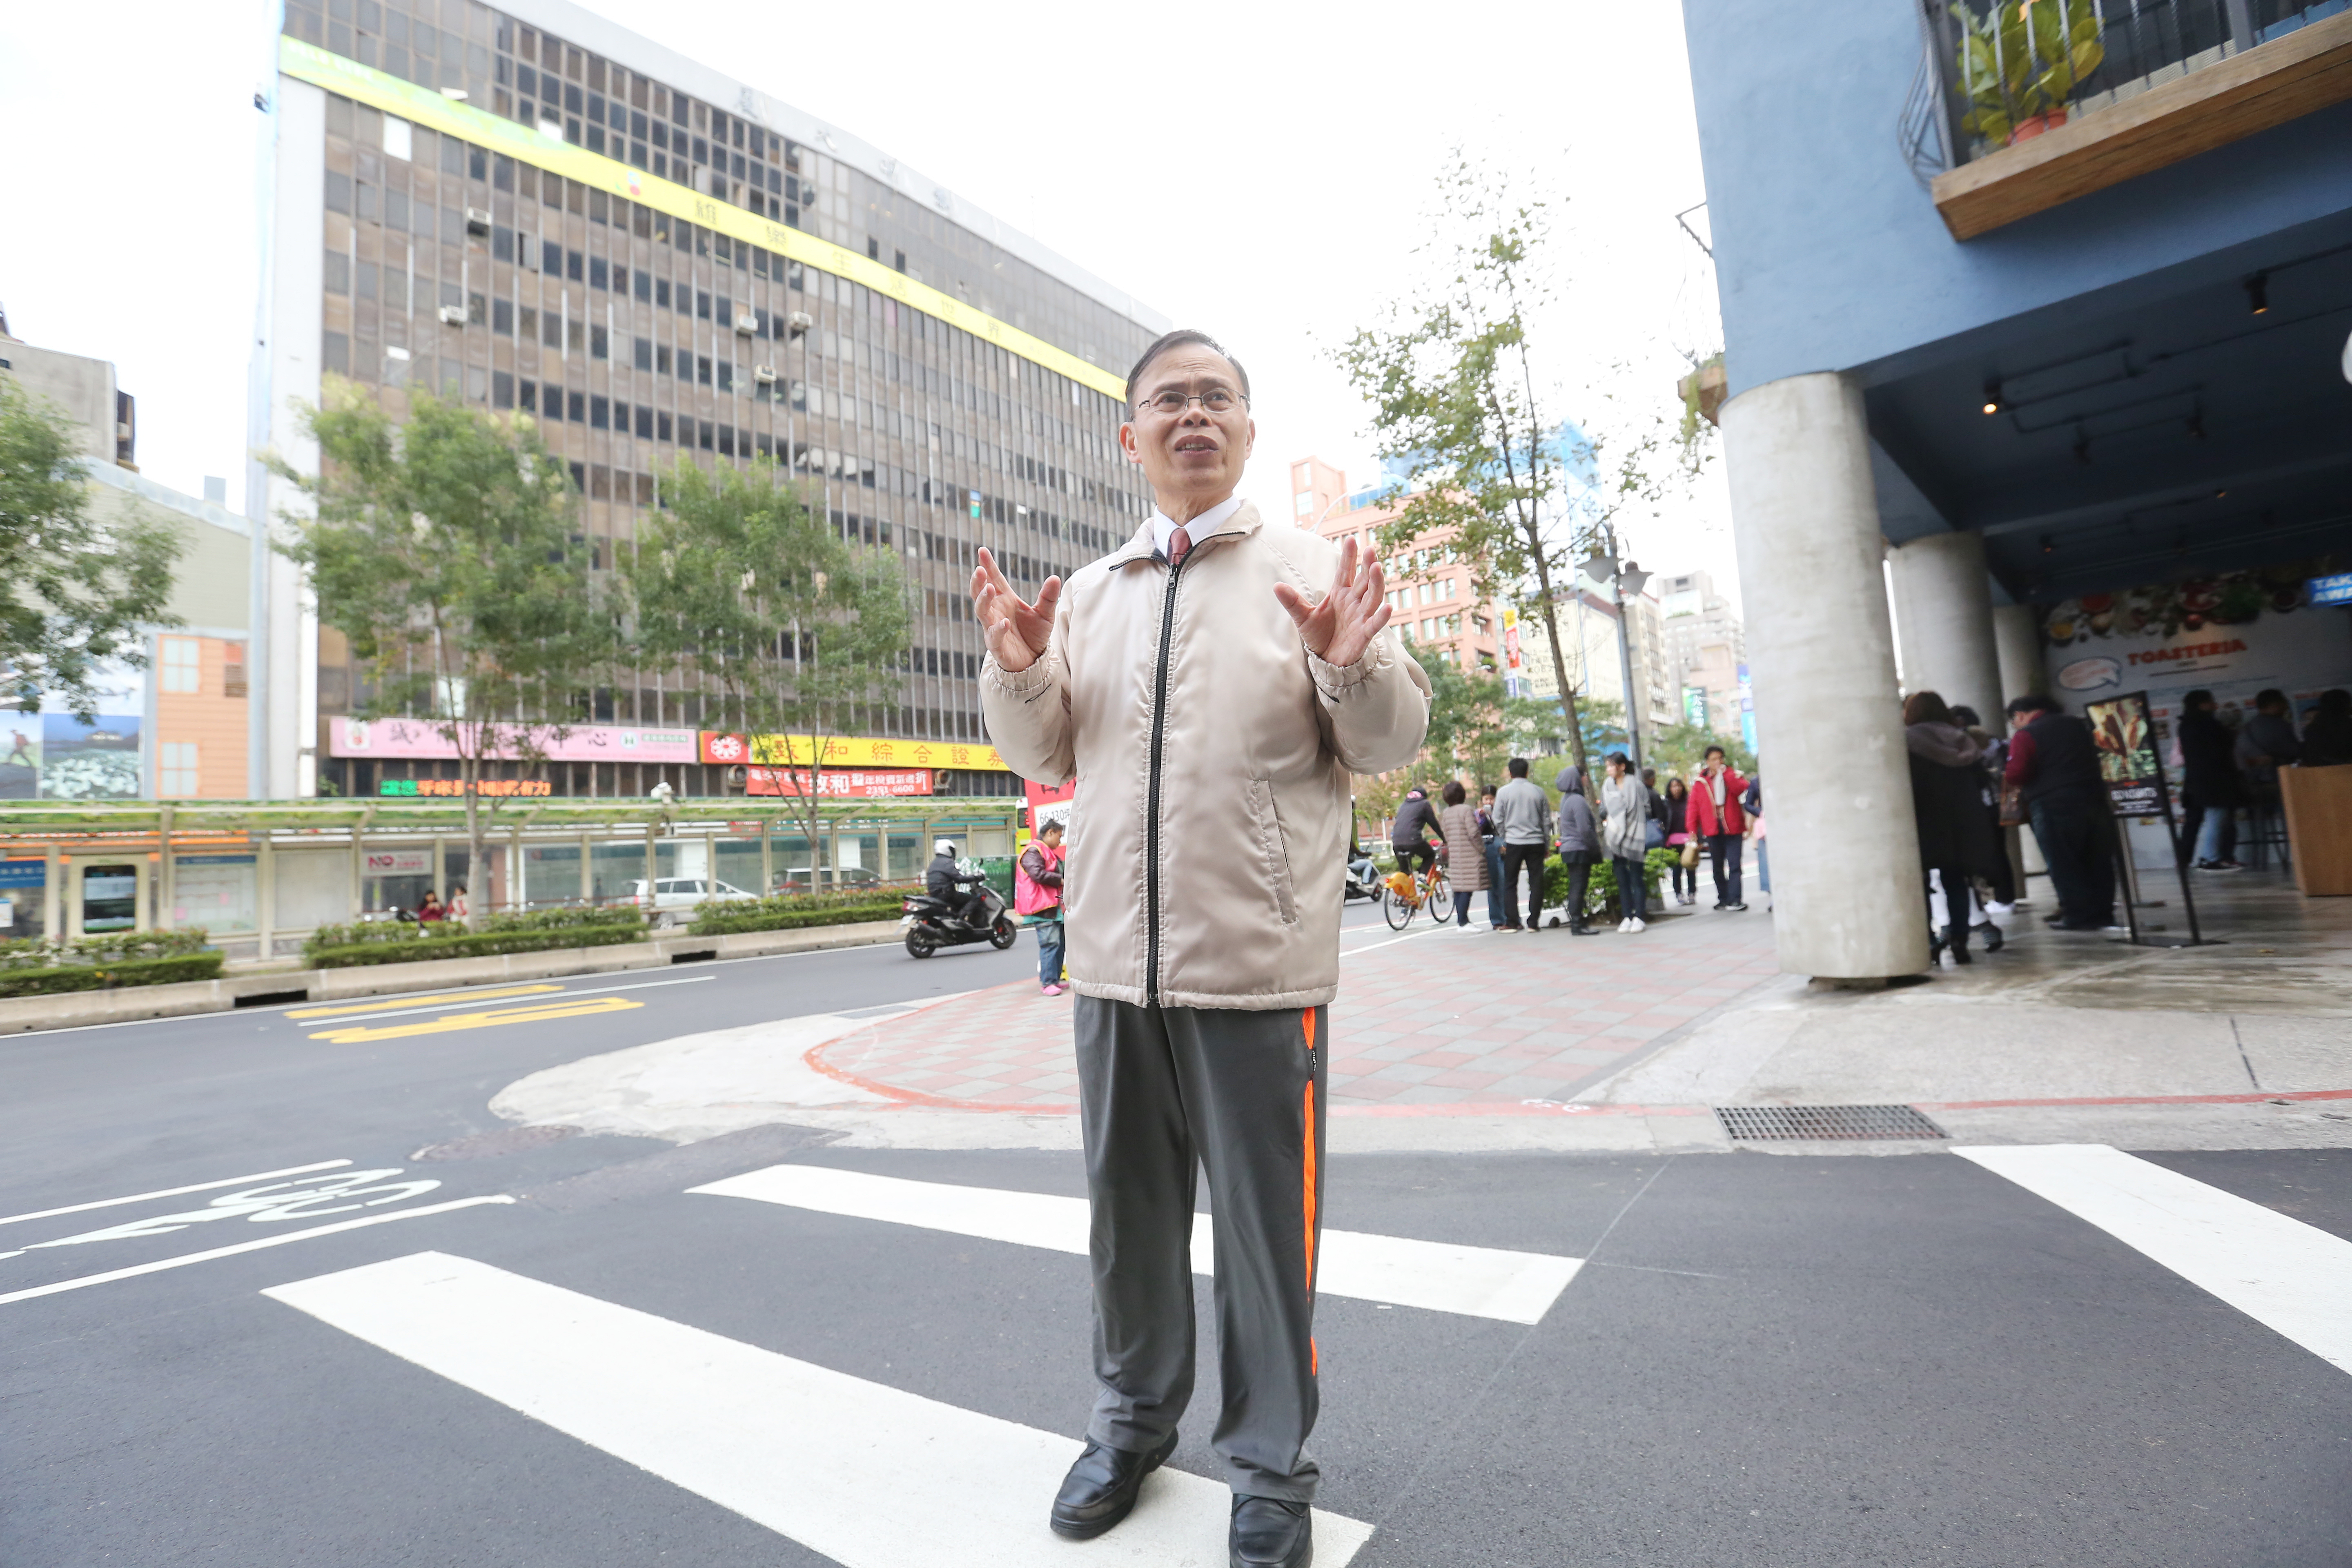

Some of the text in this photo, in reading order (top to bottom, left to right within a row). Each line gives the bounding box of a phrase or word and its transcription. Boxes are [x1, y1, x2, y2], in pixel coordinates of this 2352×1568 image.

[2127, 639, 2247, 666] TOASTERIA
[775, 739, 1003, 766] 致和綜合證券
